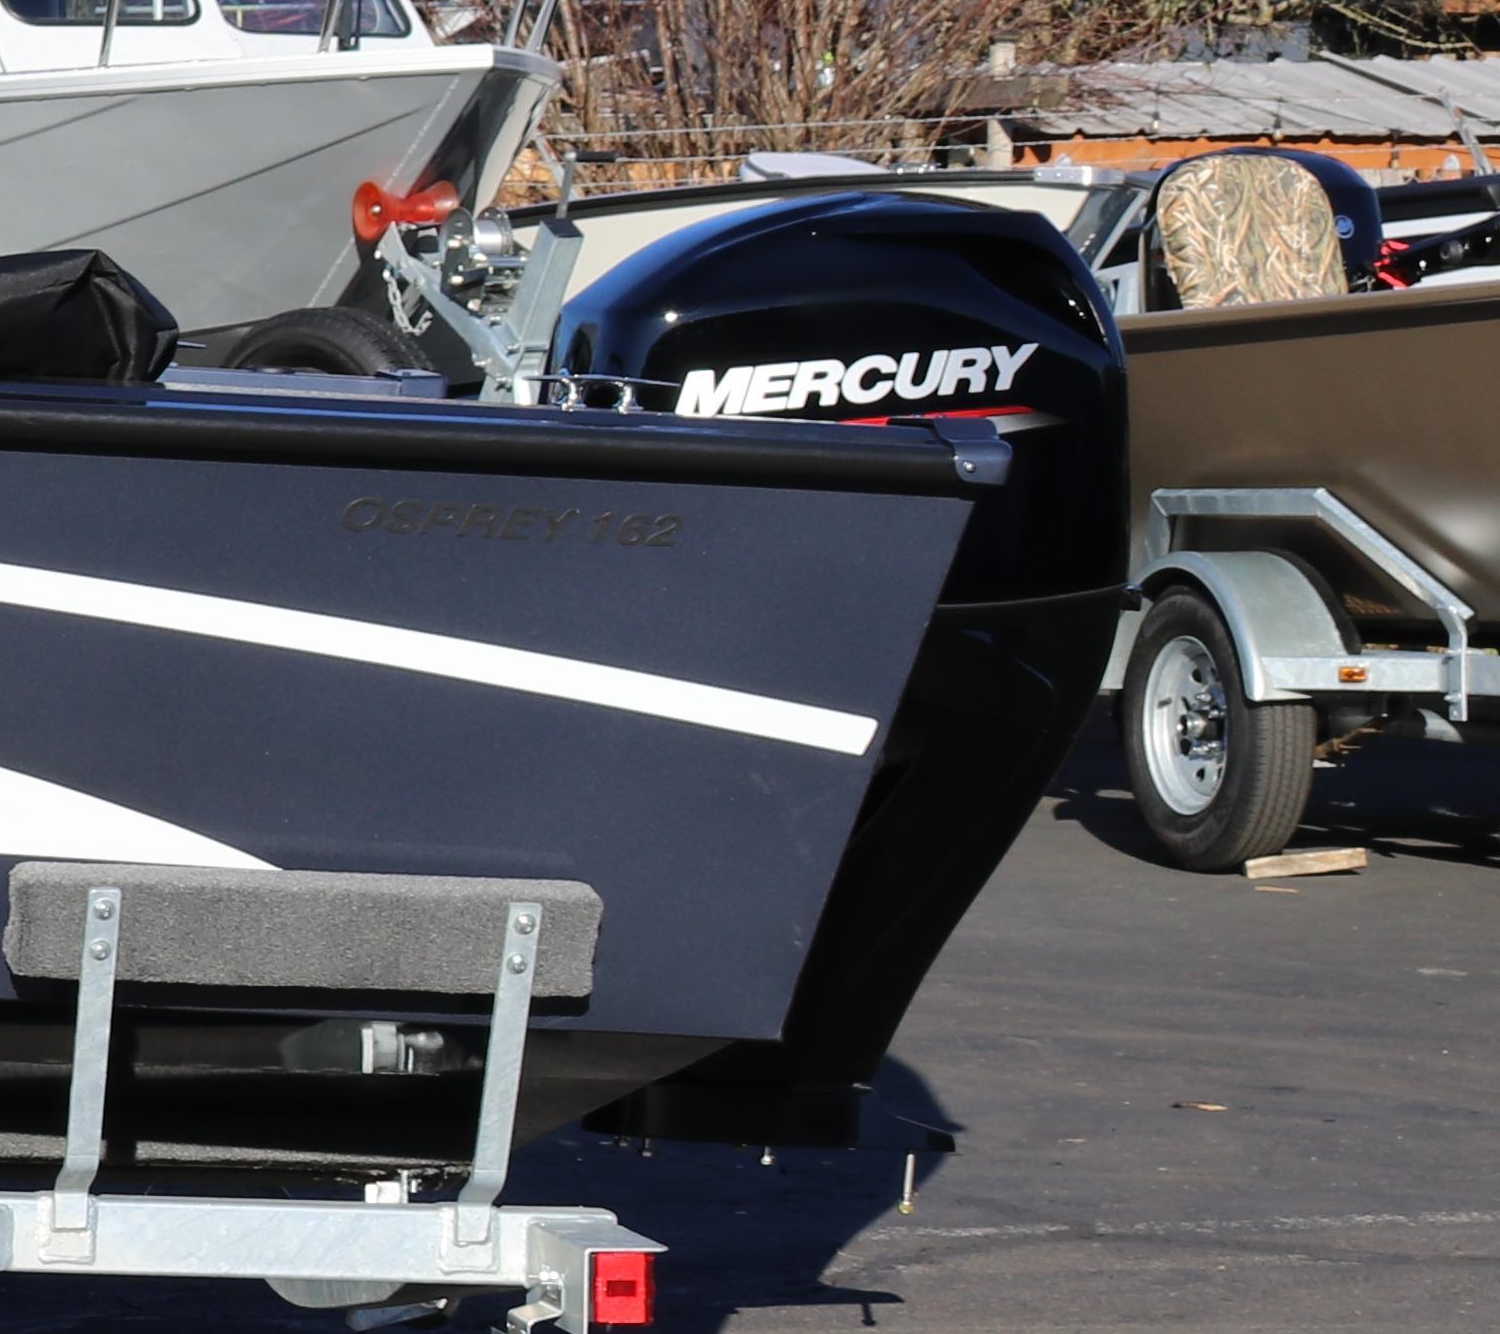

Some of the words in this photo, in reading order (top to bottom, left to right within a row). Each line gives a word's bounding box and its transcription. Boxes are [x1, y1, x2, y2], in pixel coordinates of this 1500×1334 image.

[674, 343, 1039, 417] MERCURY
[339, 496, 581, 544] OSPREY
[588, 511, 684, 547] 162
